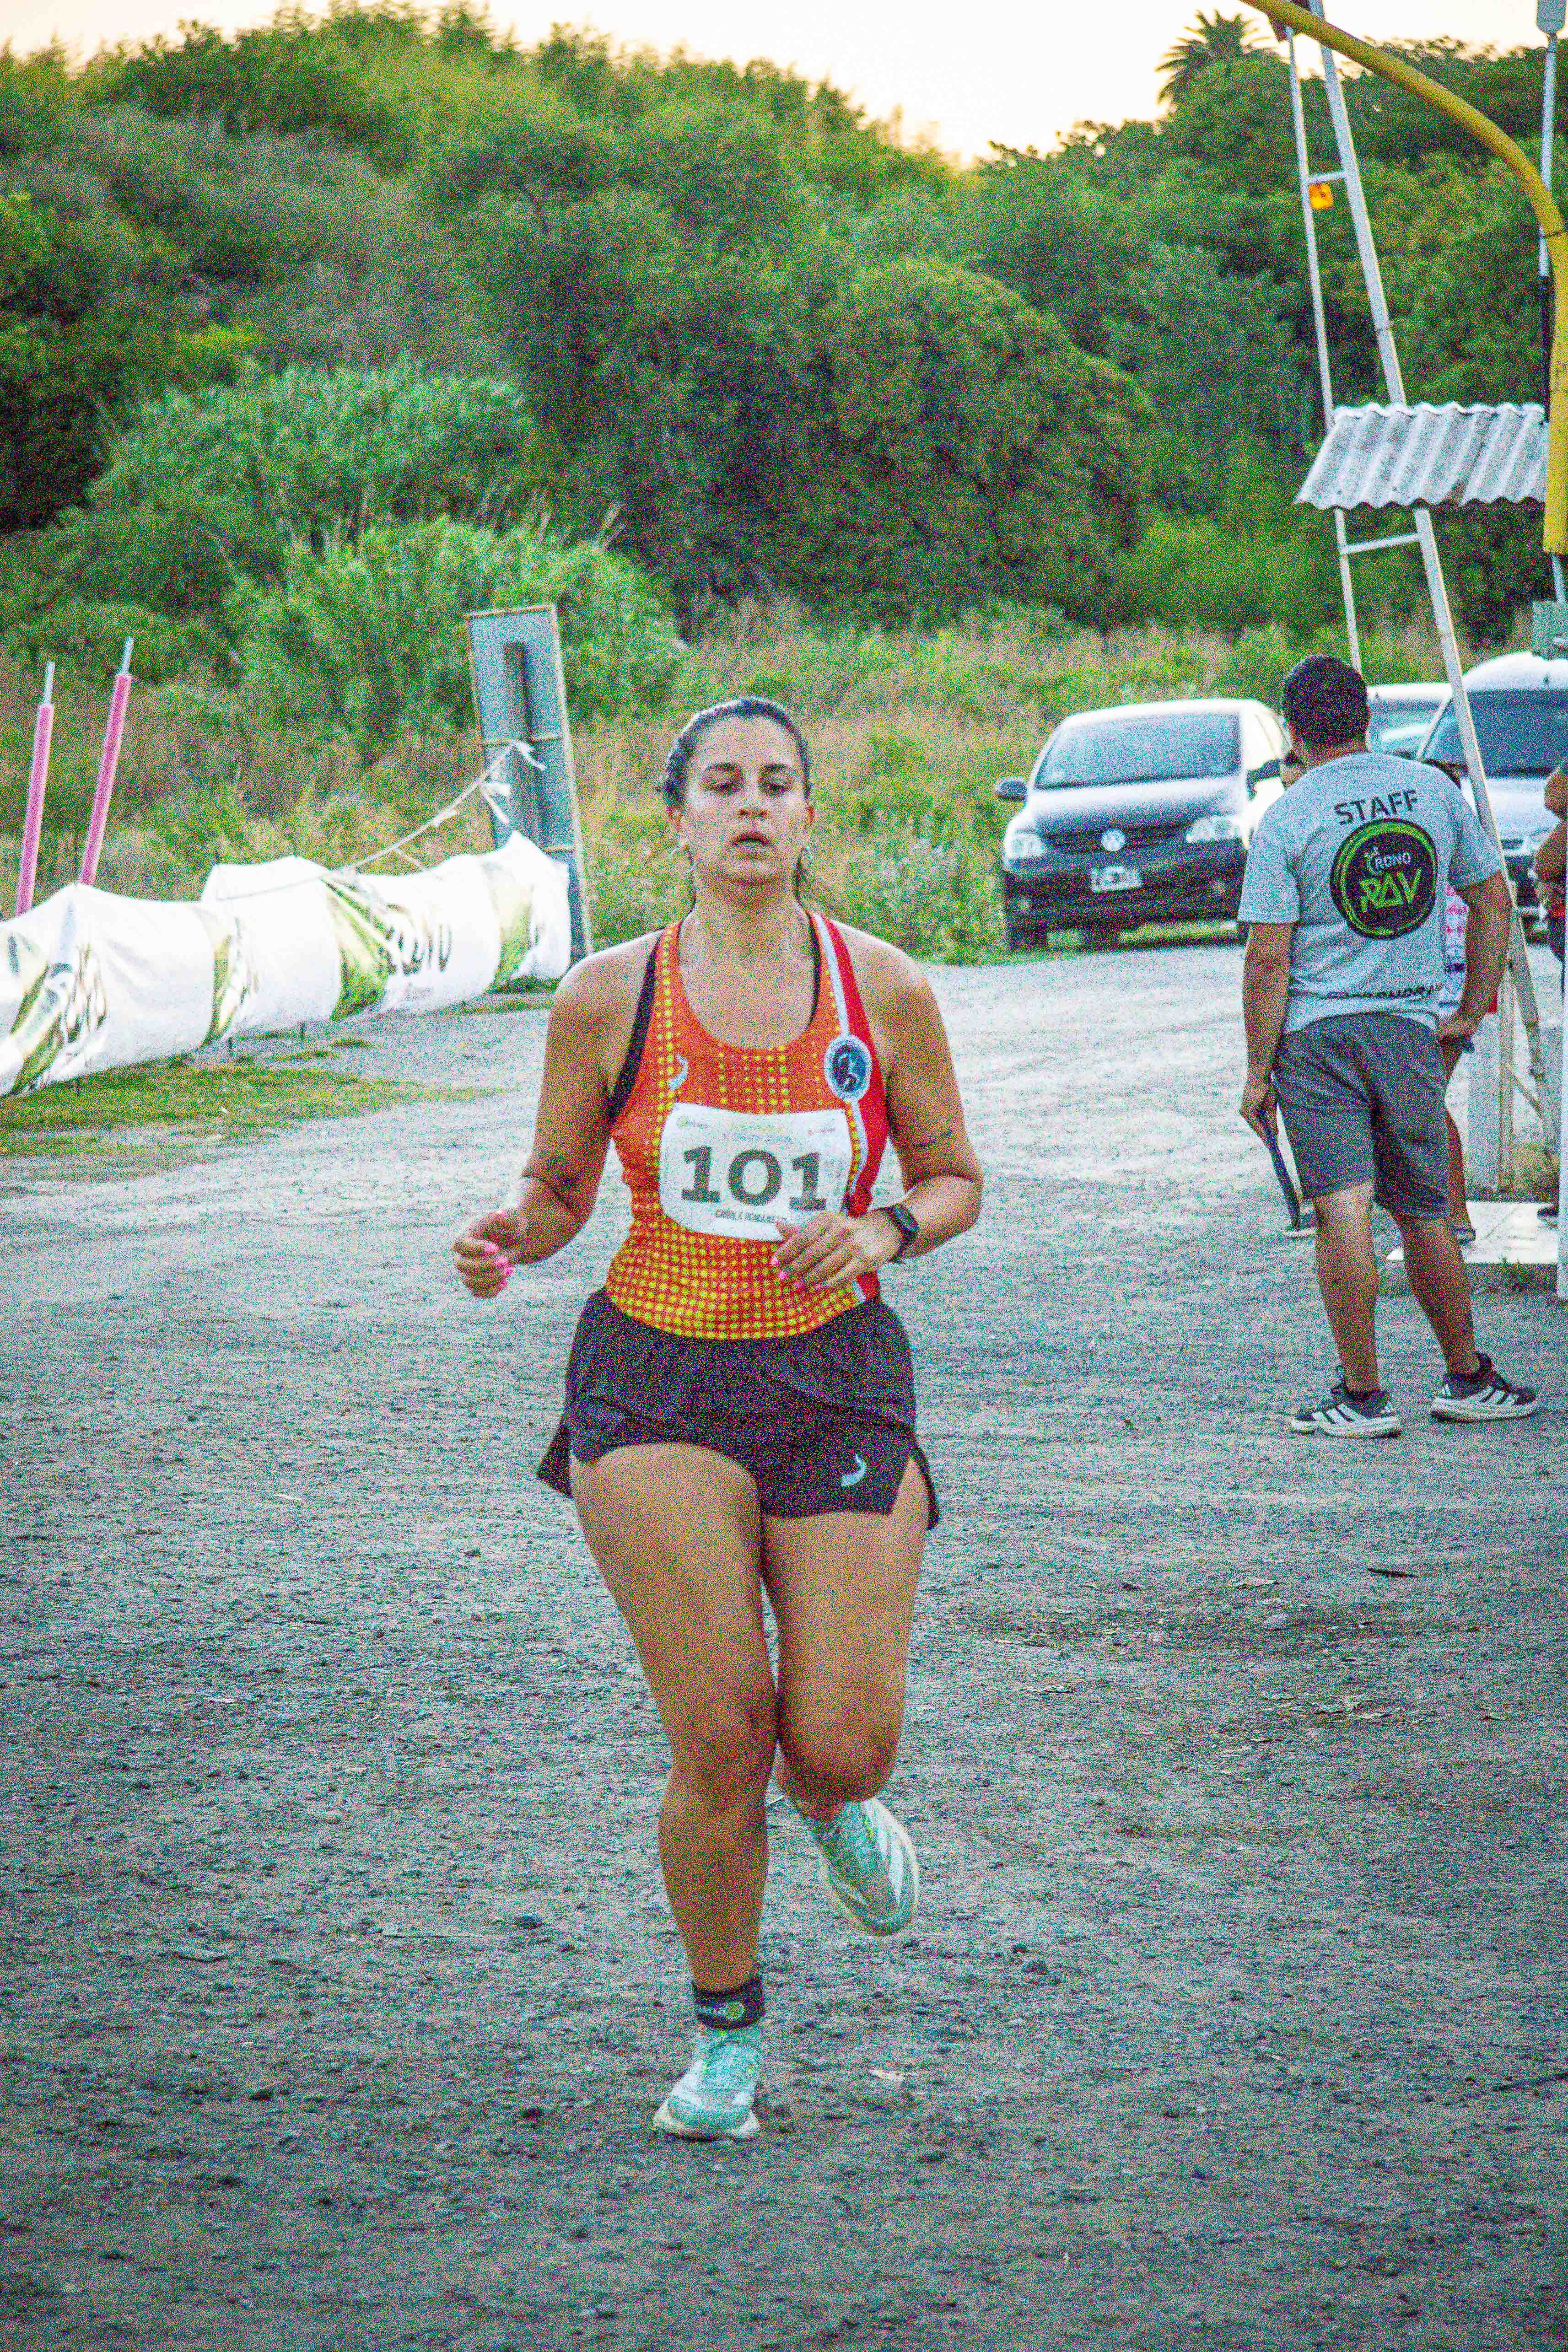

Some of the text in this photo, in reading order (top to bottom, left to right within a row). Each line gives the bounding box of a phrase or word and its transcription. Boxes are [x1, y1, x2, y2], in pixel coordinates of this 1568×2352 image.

[1334, 790, 1418, 825] STAFF
[1365, 852, 1411, 875] CRONO
[1359, 868, 1422, 913] RAV
[682, 1146, 826, 1211] 101
